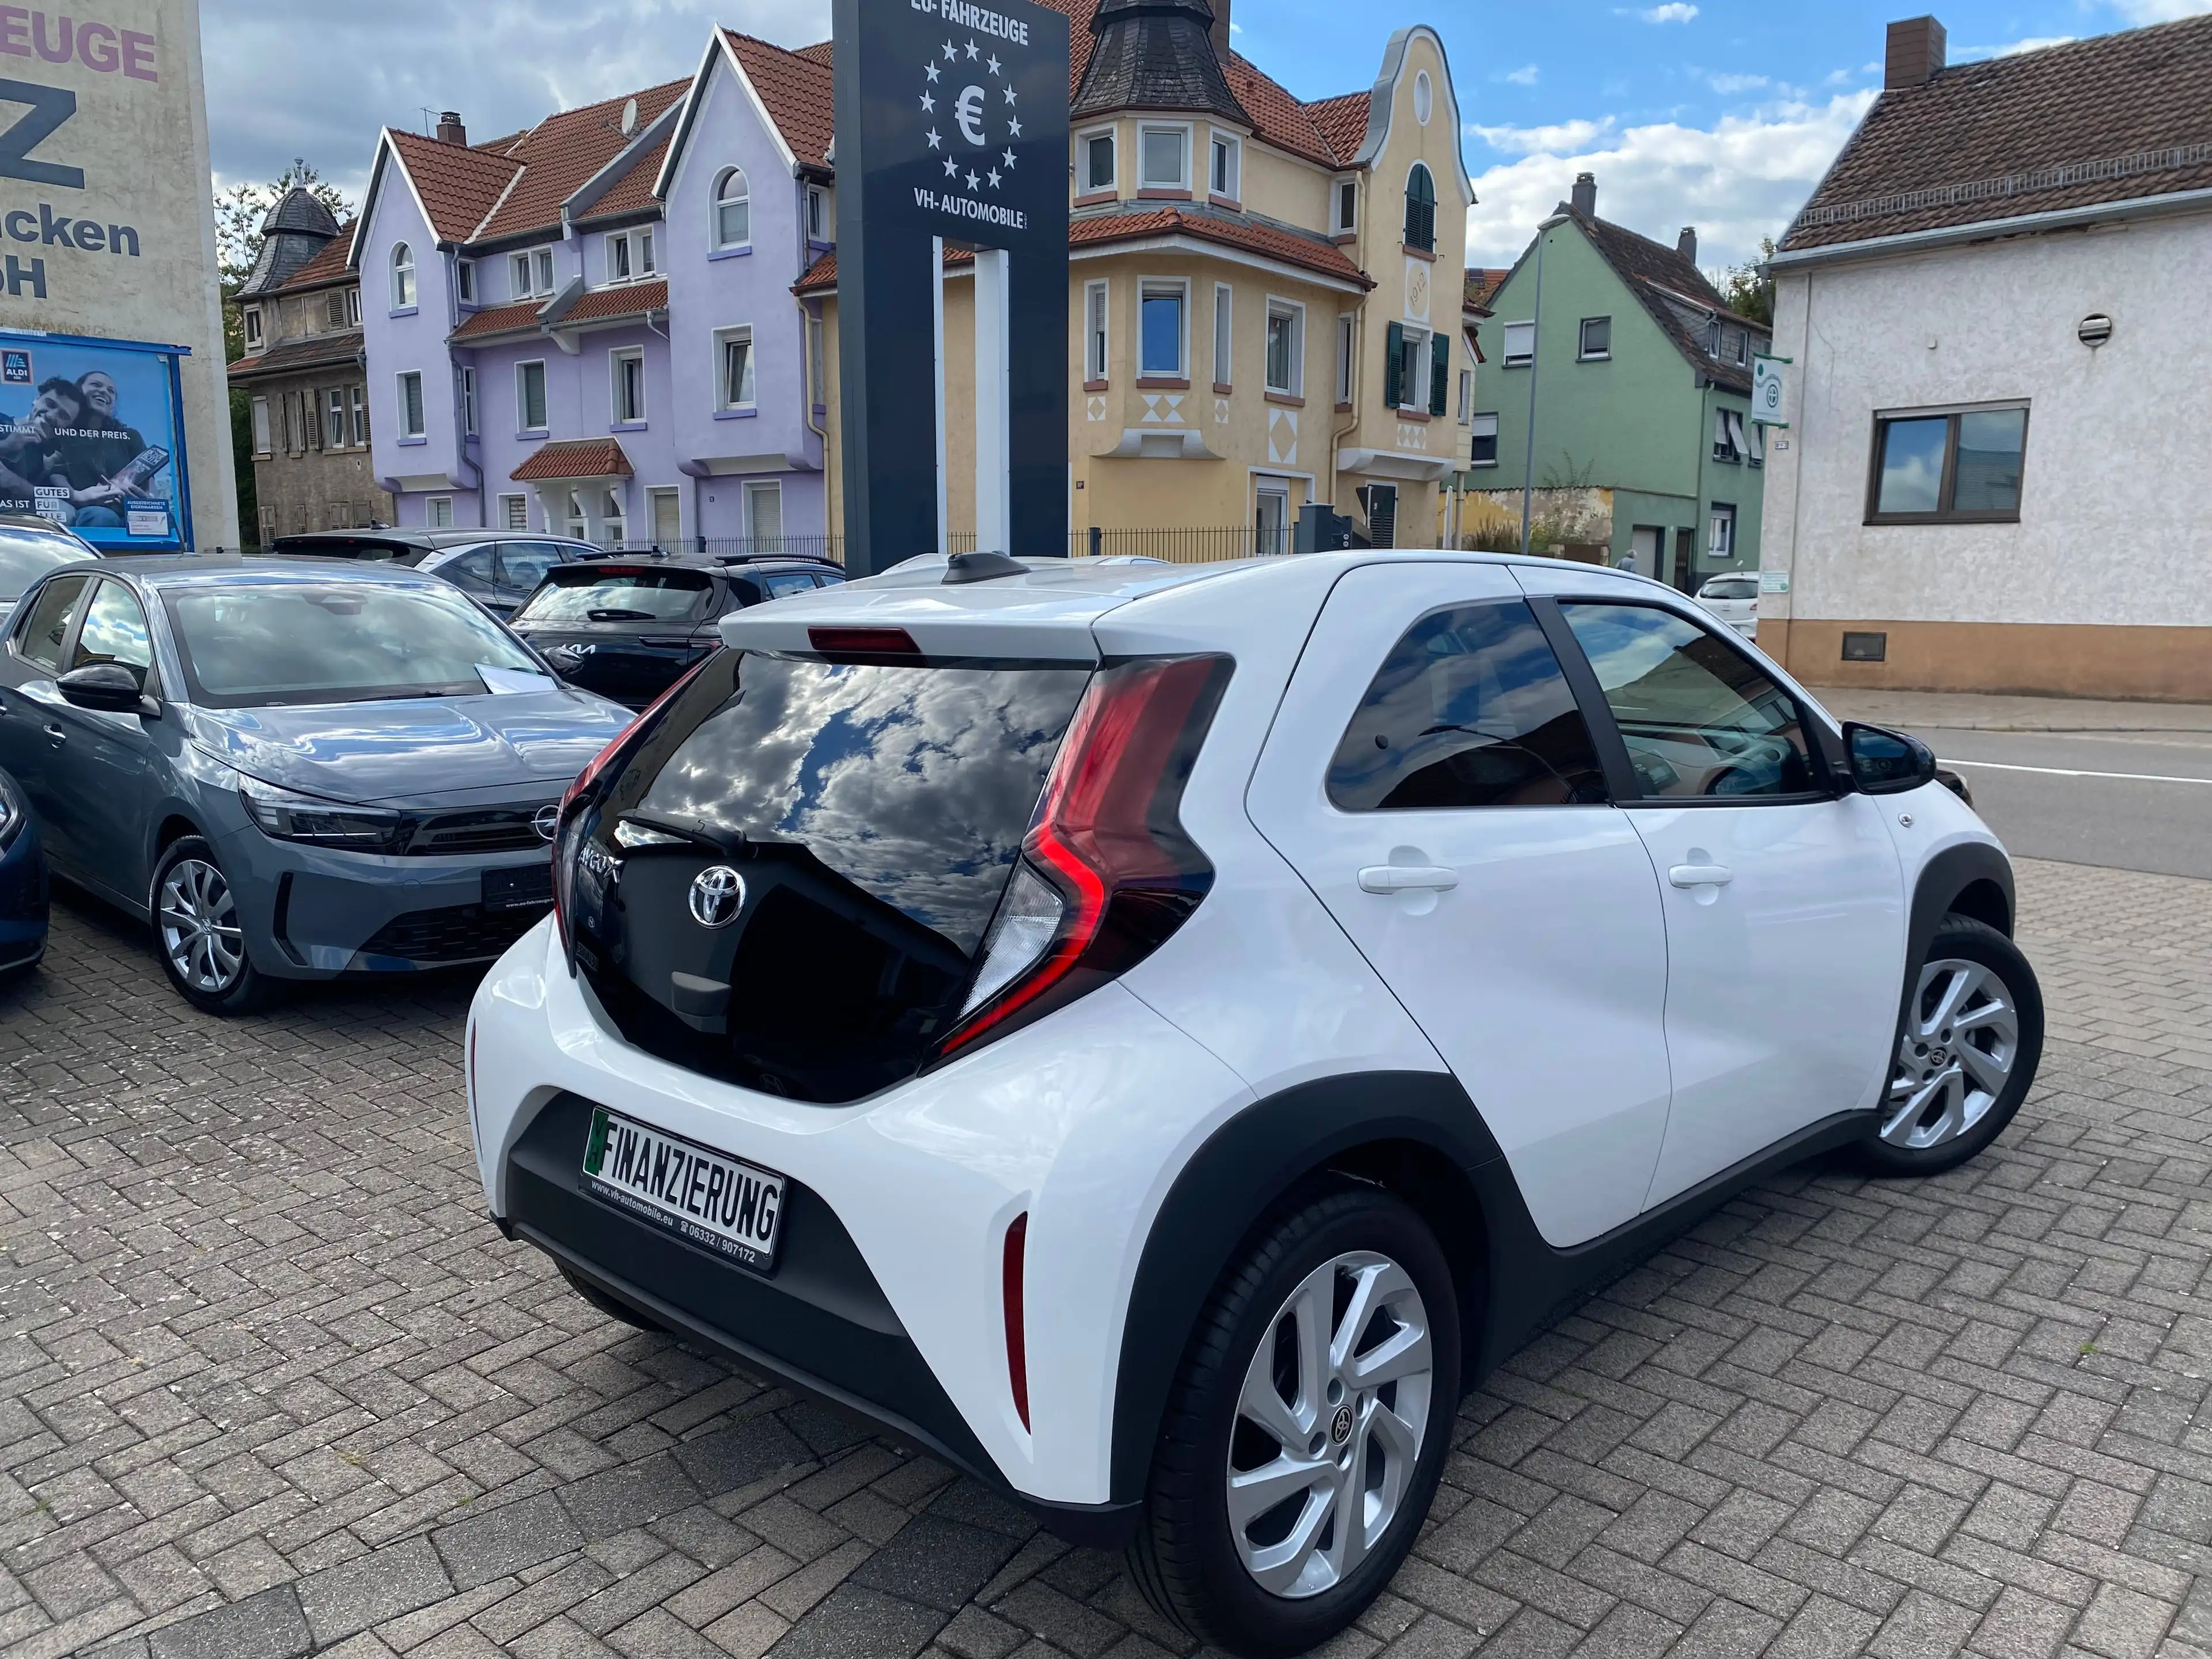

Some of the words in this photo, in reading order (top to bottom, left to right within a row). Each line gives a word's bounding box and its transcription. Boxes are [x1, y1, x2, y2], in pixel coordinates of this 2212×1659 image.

[0, 203, 140, 257] cken
[0, 255, 47, 299] H
[1410, 272, 1426, 306] 1912
[6, 368, 28, 377] ALDI
[54, 427, 77, 437] UND
[79, 429, 99, 438] DER
[101, 430, 131, 440] PREIS.
[16, 500, 30, 508] IST
[36, 488, 68, 497] GUTES
[599, 1120, 778, 1241] FINANZIERUNG
[591, 1180, 673, 1227] www.vh-automobile.eu
[689, 1226, 715, 1246] 06332
[722, 1239, 756, 1263] 907172
